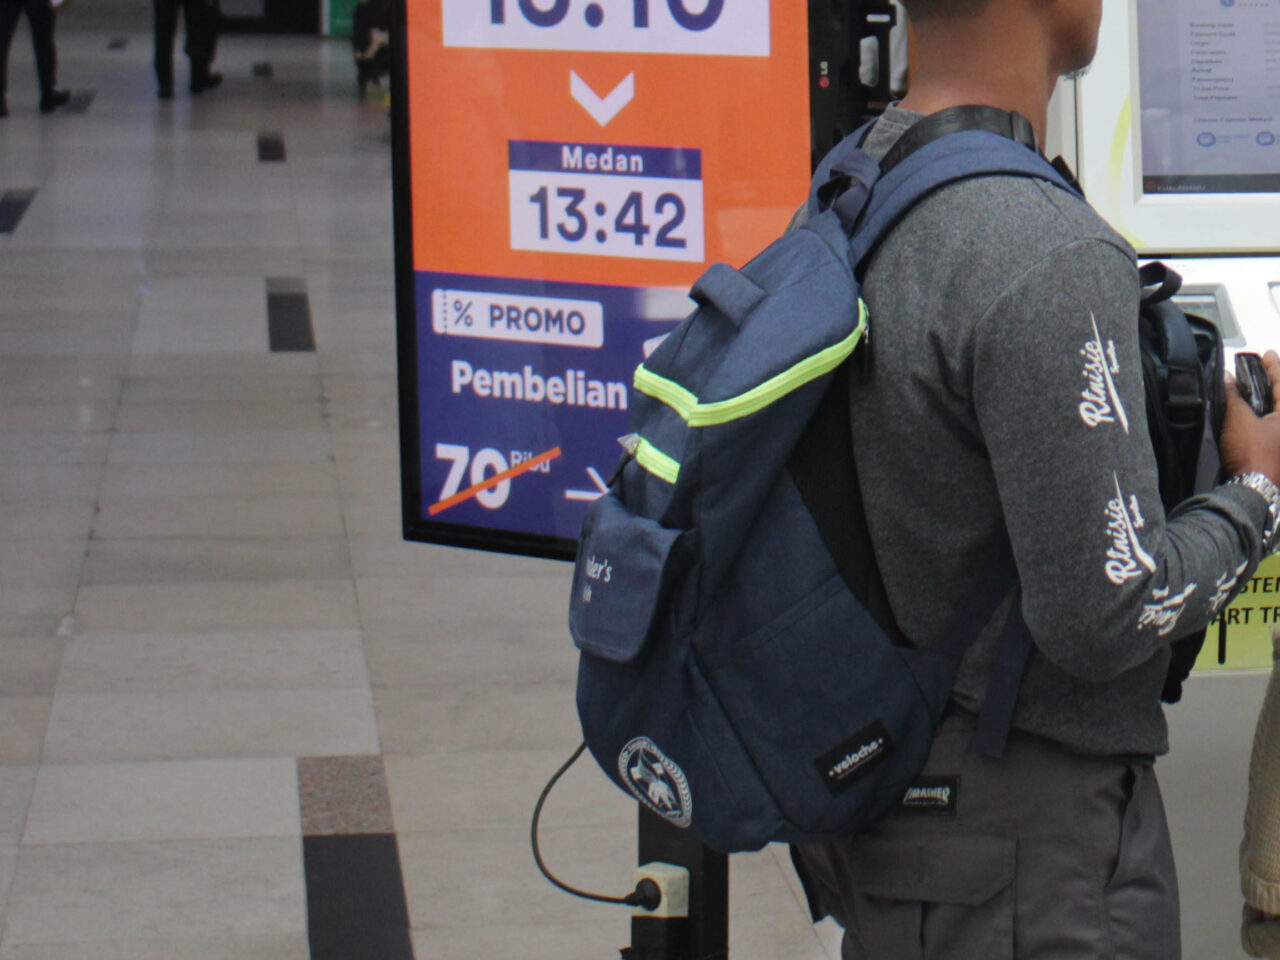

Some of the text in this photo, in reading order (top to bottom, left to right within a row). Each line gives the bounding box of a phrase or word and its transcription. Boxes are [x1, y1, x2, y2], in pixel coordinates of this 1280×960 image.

[561, 145, 644, 173] Medan
[528, 185, 688, 249] 13:42
[489, 304, 586, 336] PROMO
[451, 359, 629, 411] Pembelian
[435, 442, 511, 510] 70
[833, 740, 879, 775] veloche
